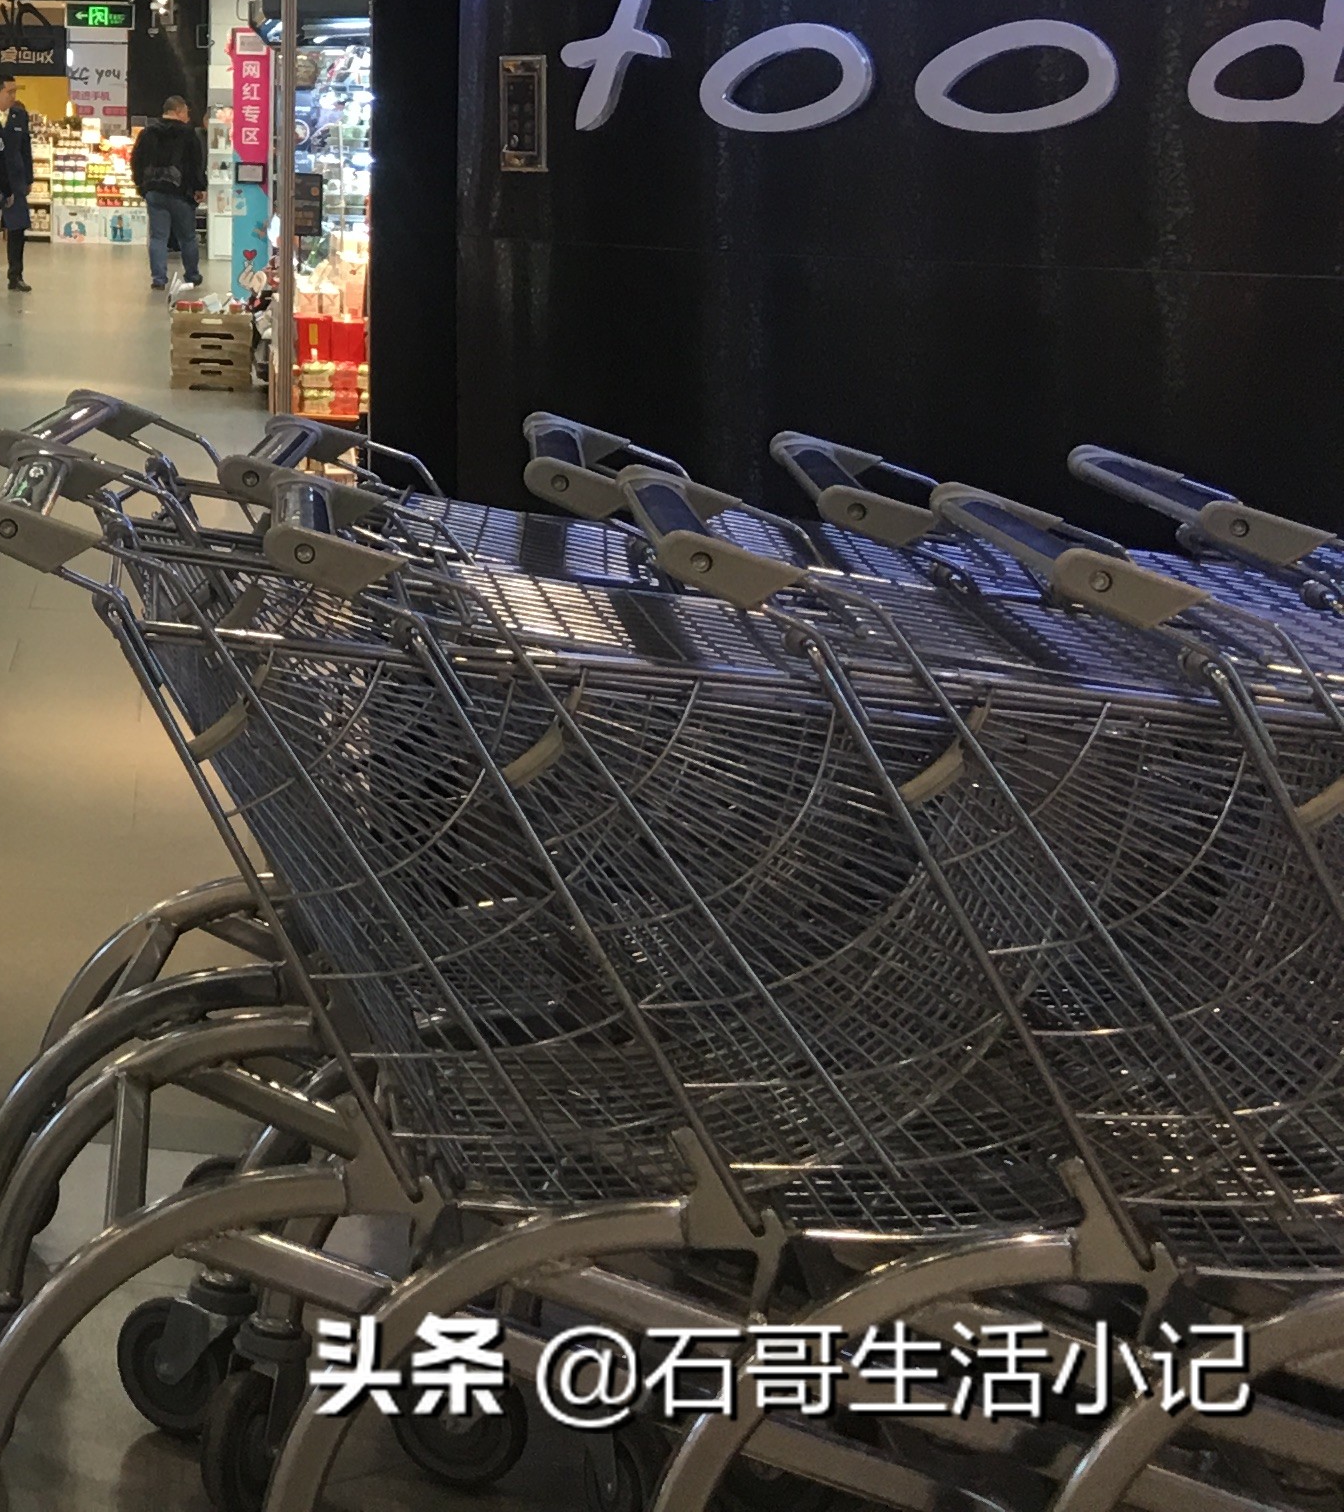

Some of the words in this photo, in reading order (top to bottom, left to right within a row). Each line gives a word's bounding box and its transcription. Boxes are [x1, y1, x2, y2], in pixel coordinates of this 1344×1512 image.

[0, 46, 55, 65] 爱回收
[241, 60, 261, 146] 网红专区
